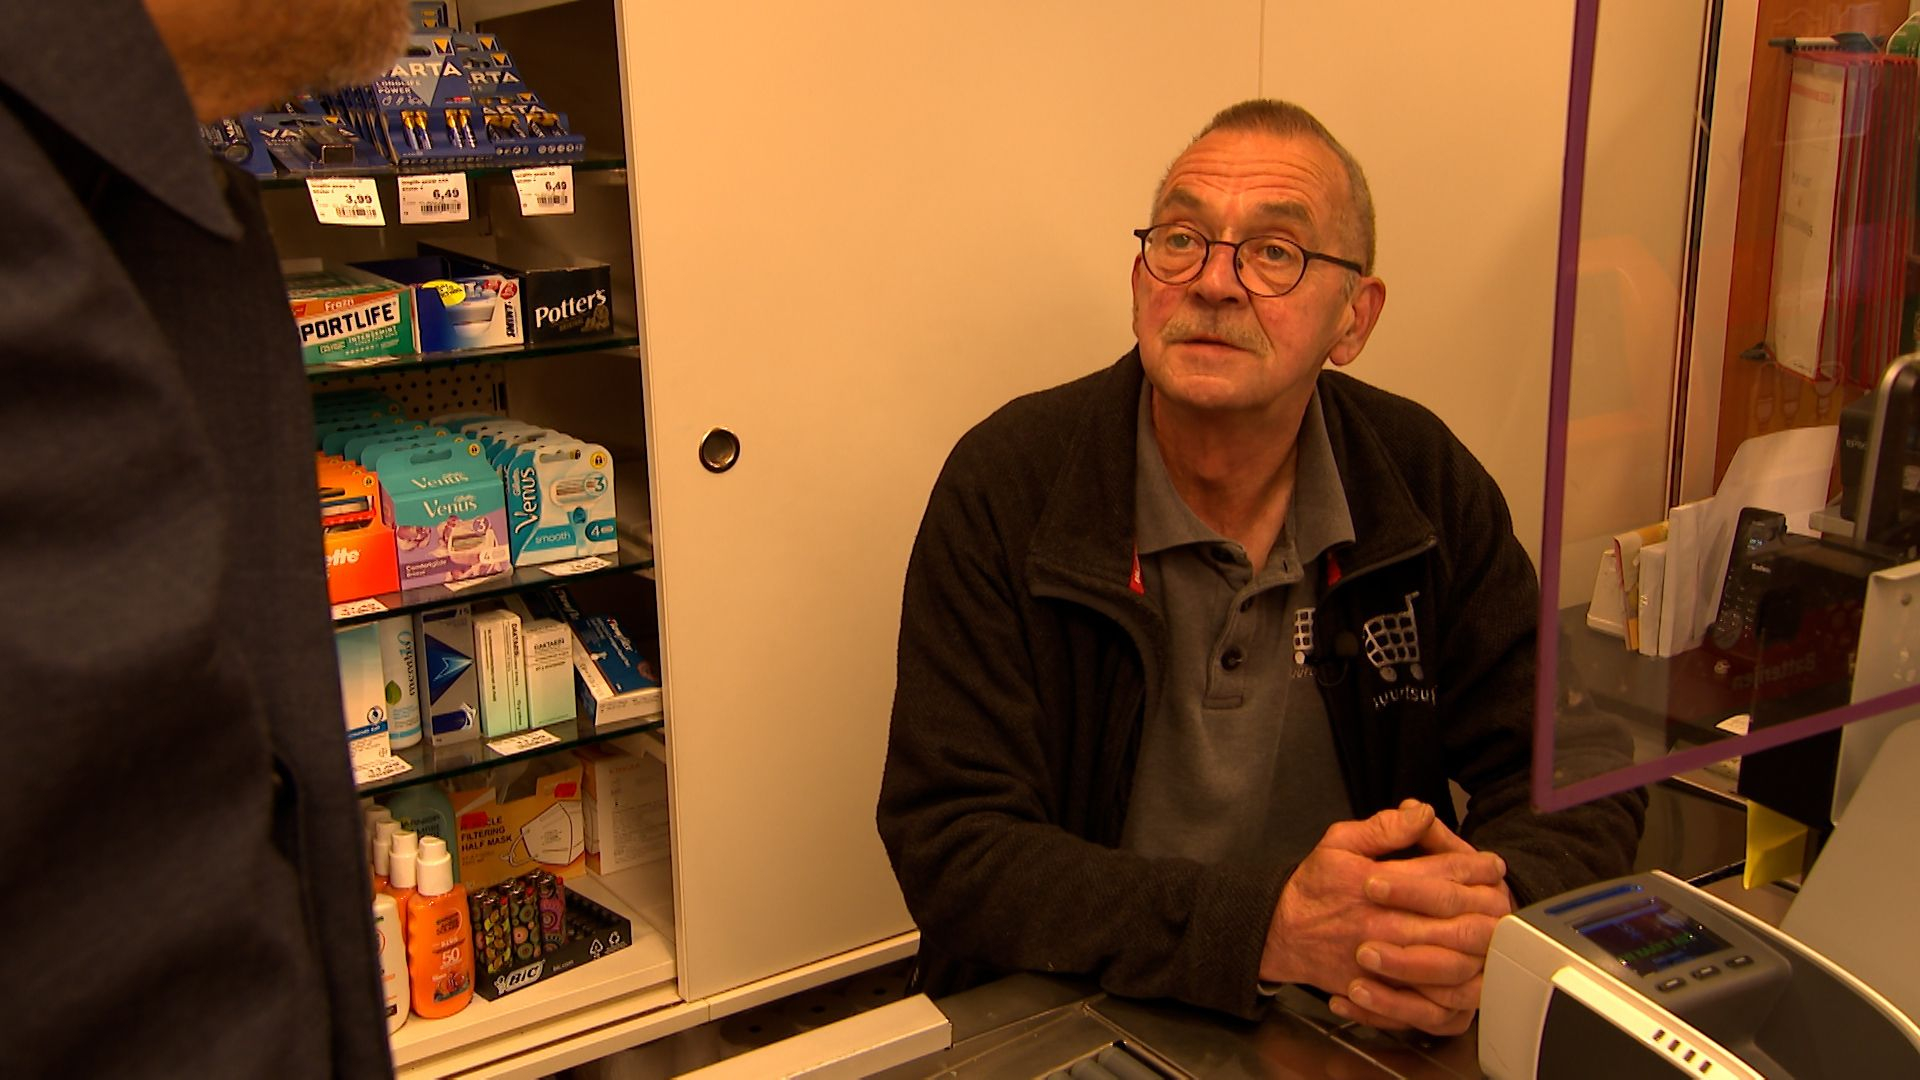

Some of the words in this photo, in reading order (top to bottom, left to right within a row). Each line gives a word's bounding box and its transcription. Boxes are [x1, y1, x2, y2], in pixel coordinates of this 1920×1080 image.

[381, 63, 463, 77] ARTA
[467, 71, 521, 84] RTA
[432, 189, 460, 200] 6,49
[535, 288, 607, 328] Potter's
[300, 303, 395, 342] PORTLIFE
[594, 476, 605, 492] 3
[513, 467, 540, 534] Venus
[423, 499, 477, 519] Venus
[590, 525, 600, 538] 4
[460, 826, 505, 841] FILTERING
[461, 840, 484, 852] HALF
[487, 834, 513, 846] MASK
[442, 948, 460, 964] 50
[508, 963, 541, 987] BIC
